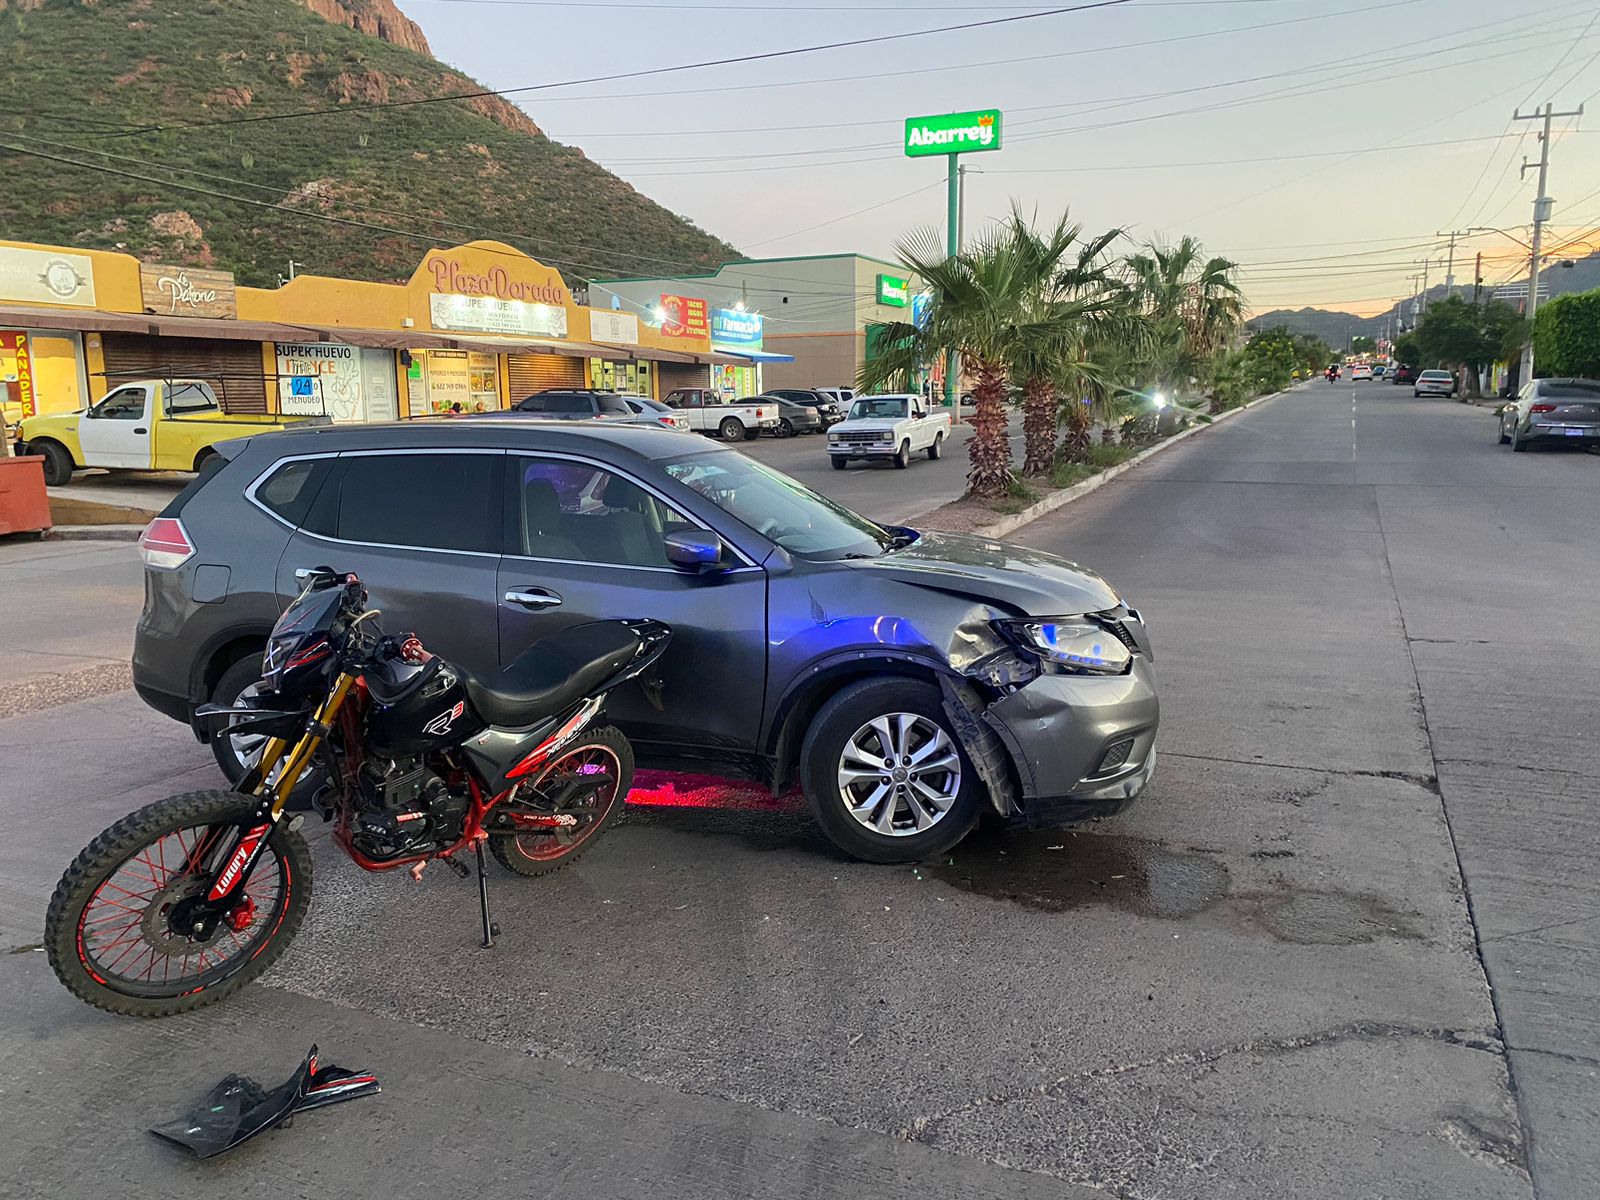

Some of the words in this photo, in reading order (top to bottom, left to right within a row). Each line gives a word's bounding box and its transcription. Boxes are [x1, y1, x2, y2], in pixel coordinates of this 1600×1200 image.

[907, 125, 994, 147] Abarrey
[157, 277, 216, 312] Patrona
[428, 257, 493, 295] Plaza
[488, 265, 563, 305] Dorada
[276, 344, 313, 357] SUPER
[316, 347, 351, 359] HUEVO
[15, 335, 33, 417] PANADER
